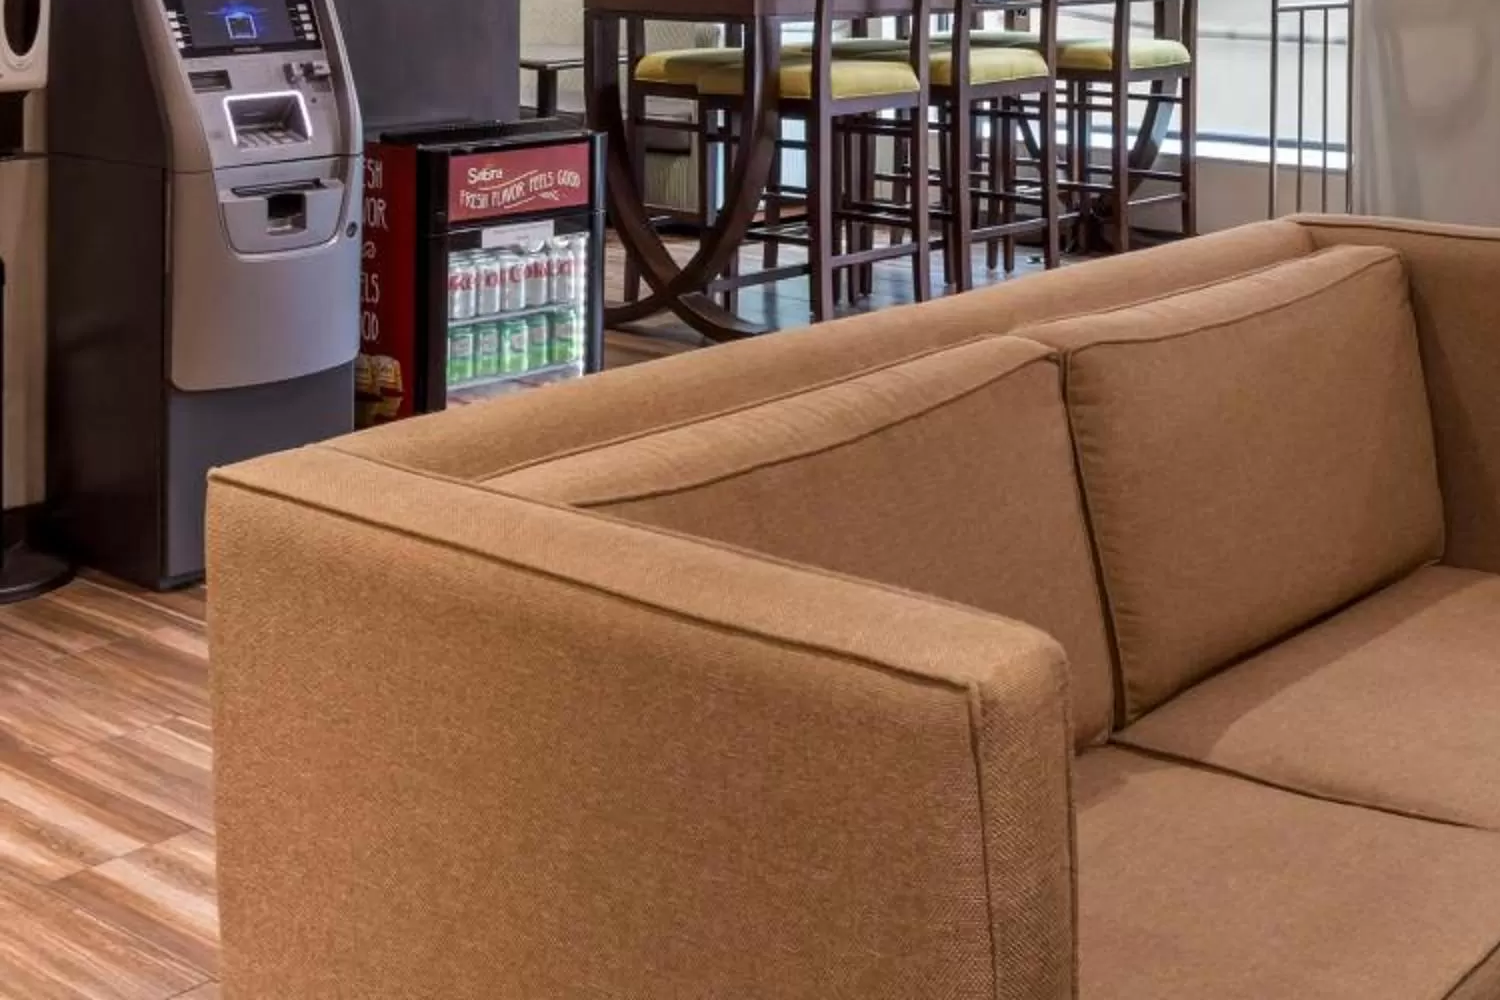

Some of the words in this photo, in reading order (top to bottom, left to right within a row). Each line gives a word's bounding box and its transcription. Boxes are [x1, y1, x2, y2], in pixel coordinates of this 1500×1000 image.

[460, 188, 489, 209] FRESH
[491, 181, 526, 208] FLAVOR
[529, 171, 555, 192] FEELS
[557, 168, 581, 188] GOOD
[468, 167, 503, 184] Sabra
